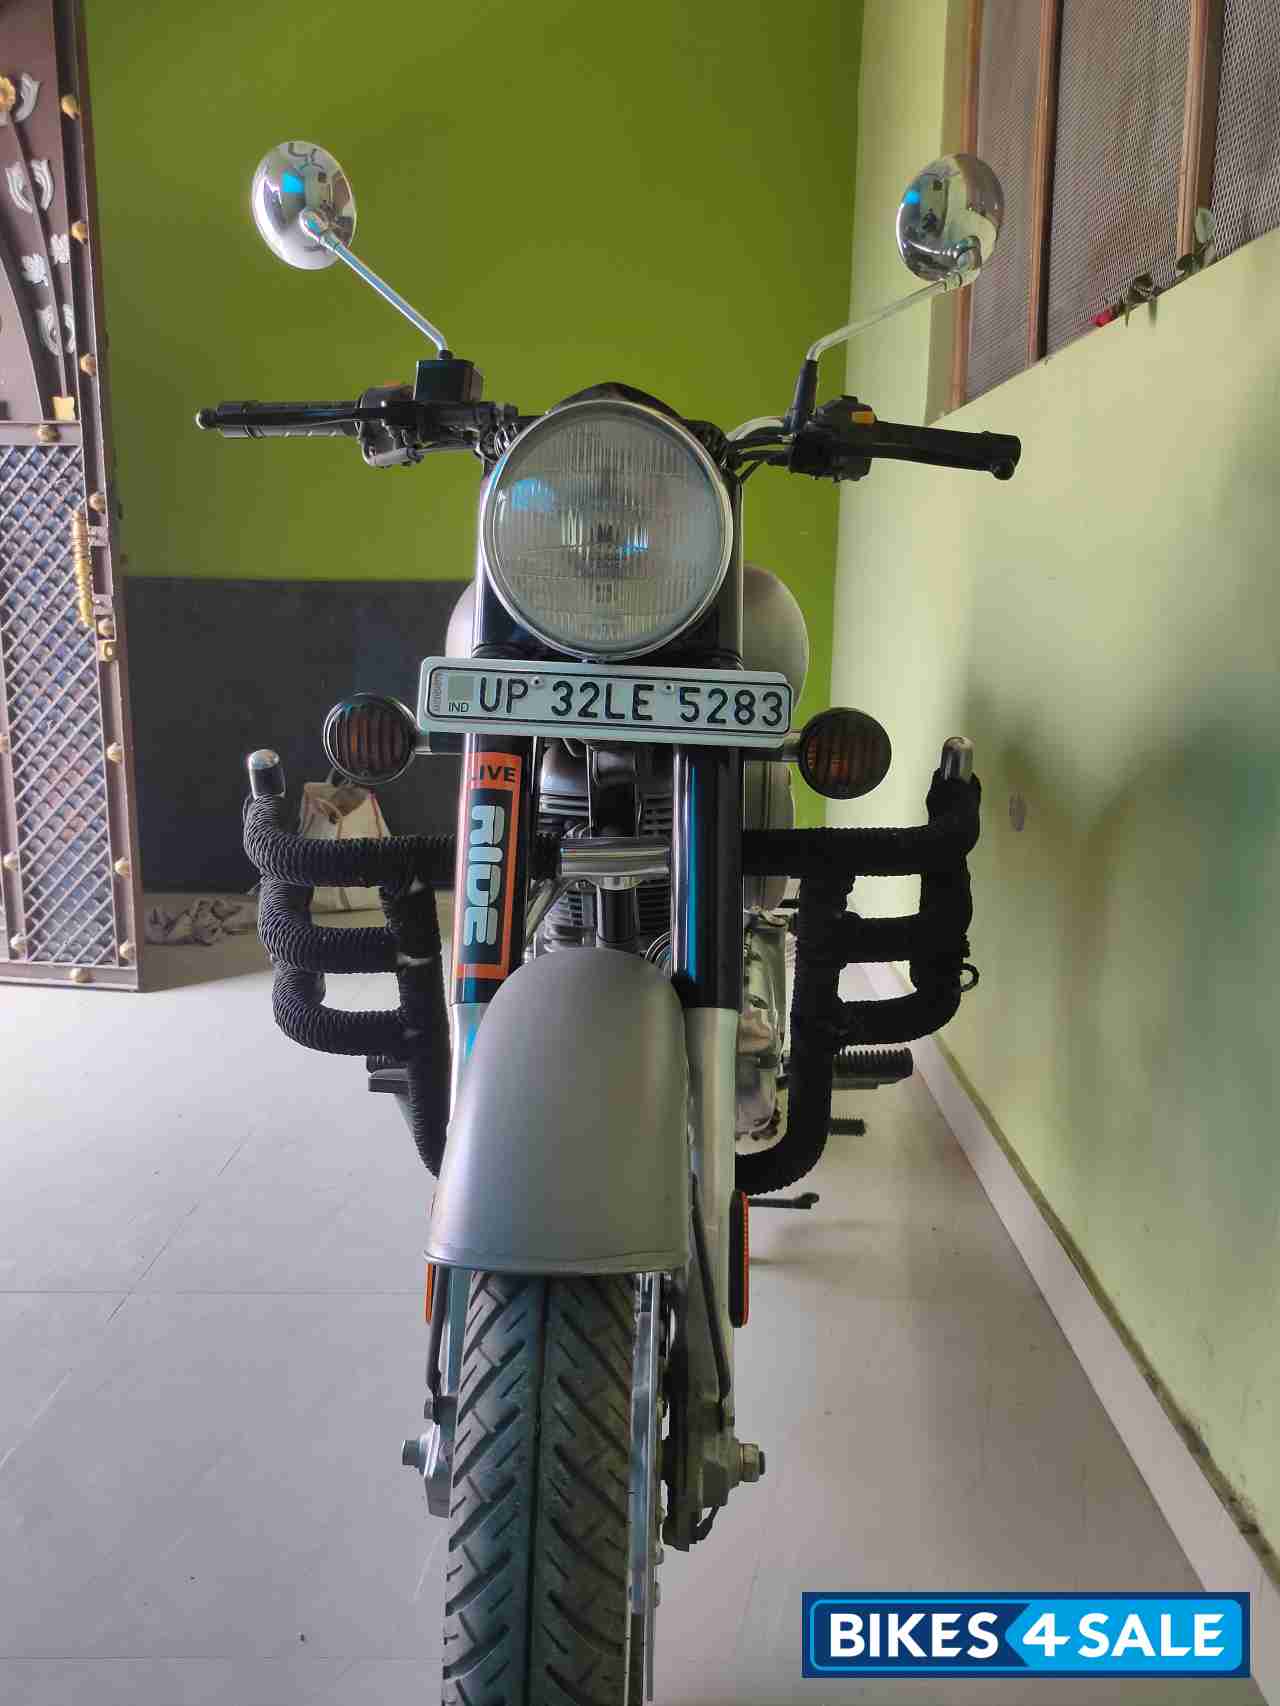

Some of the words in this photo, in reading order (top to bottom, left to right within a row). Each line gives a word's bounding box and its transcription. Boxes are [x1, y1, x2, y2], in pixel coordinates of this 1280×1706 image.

[448, 702, 470, 713] IND
[480, 676, 528, 714] UP
[551, 680, 655, 721] 32LE
[679, 687, 784, 727] 5283
[471, 764, 516, 783] IVE
